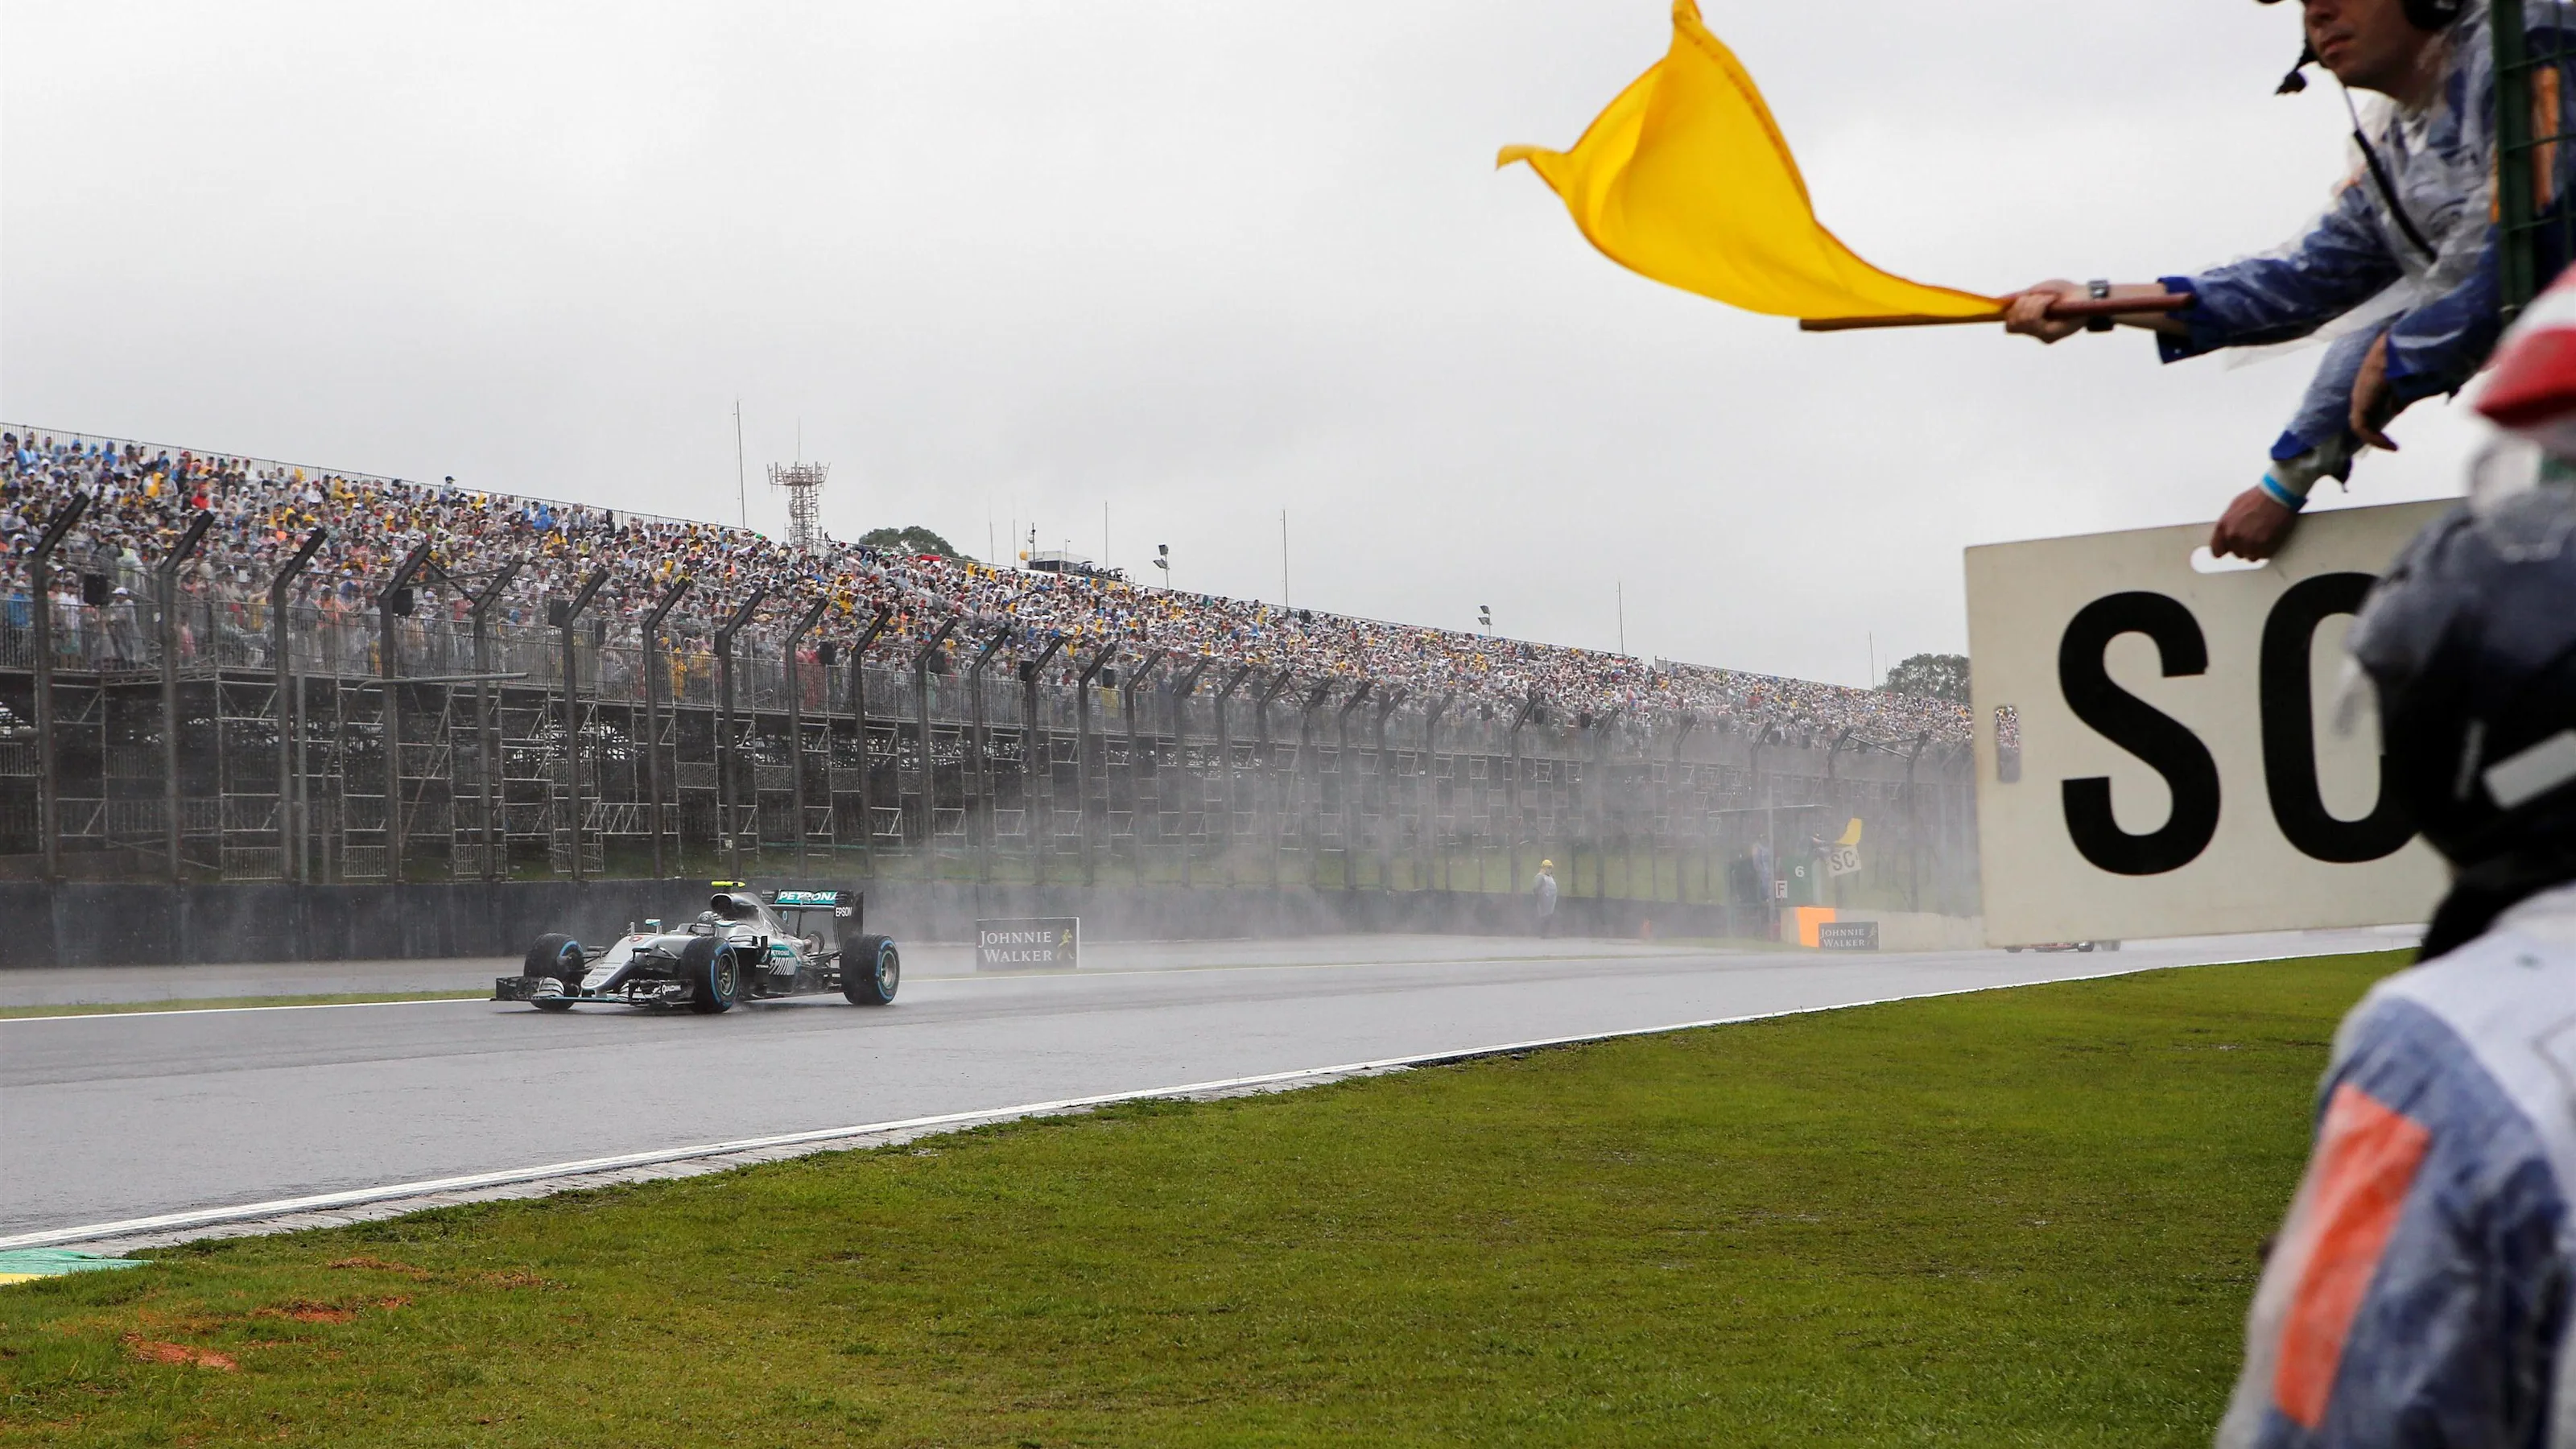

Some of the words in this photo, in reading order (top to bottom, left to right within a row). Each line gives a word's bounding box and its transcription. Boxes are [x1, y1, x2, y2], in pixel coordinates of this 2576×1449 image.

[1831, 850, 1856, 871] SC
[1795, 865, 1805, 877] 6
[1777, 882, 1785, 897] F
[836, 906, 852, 917] EPSON
[978, 931, 1051, 947] JOHNNIE
[1820, 929, 1864, 938] JOHNNIE
[1823, 939, 1865, 947] WALKER
[984, 949, 1052, 963] WALKER
